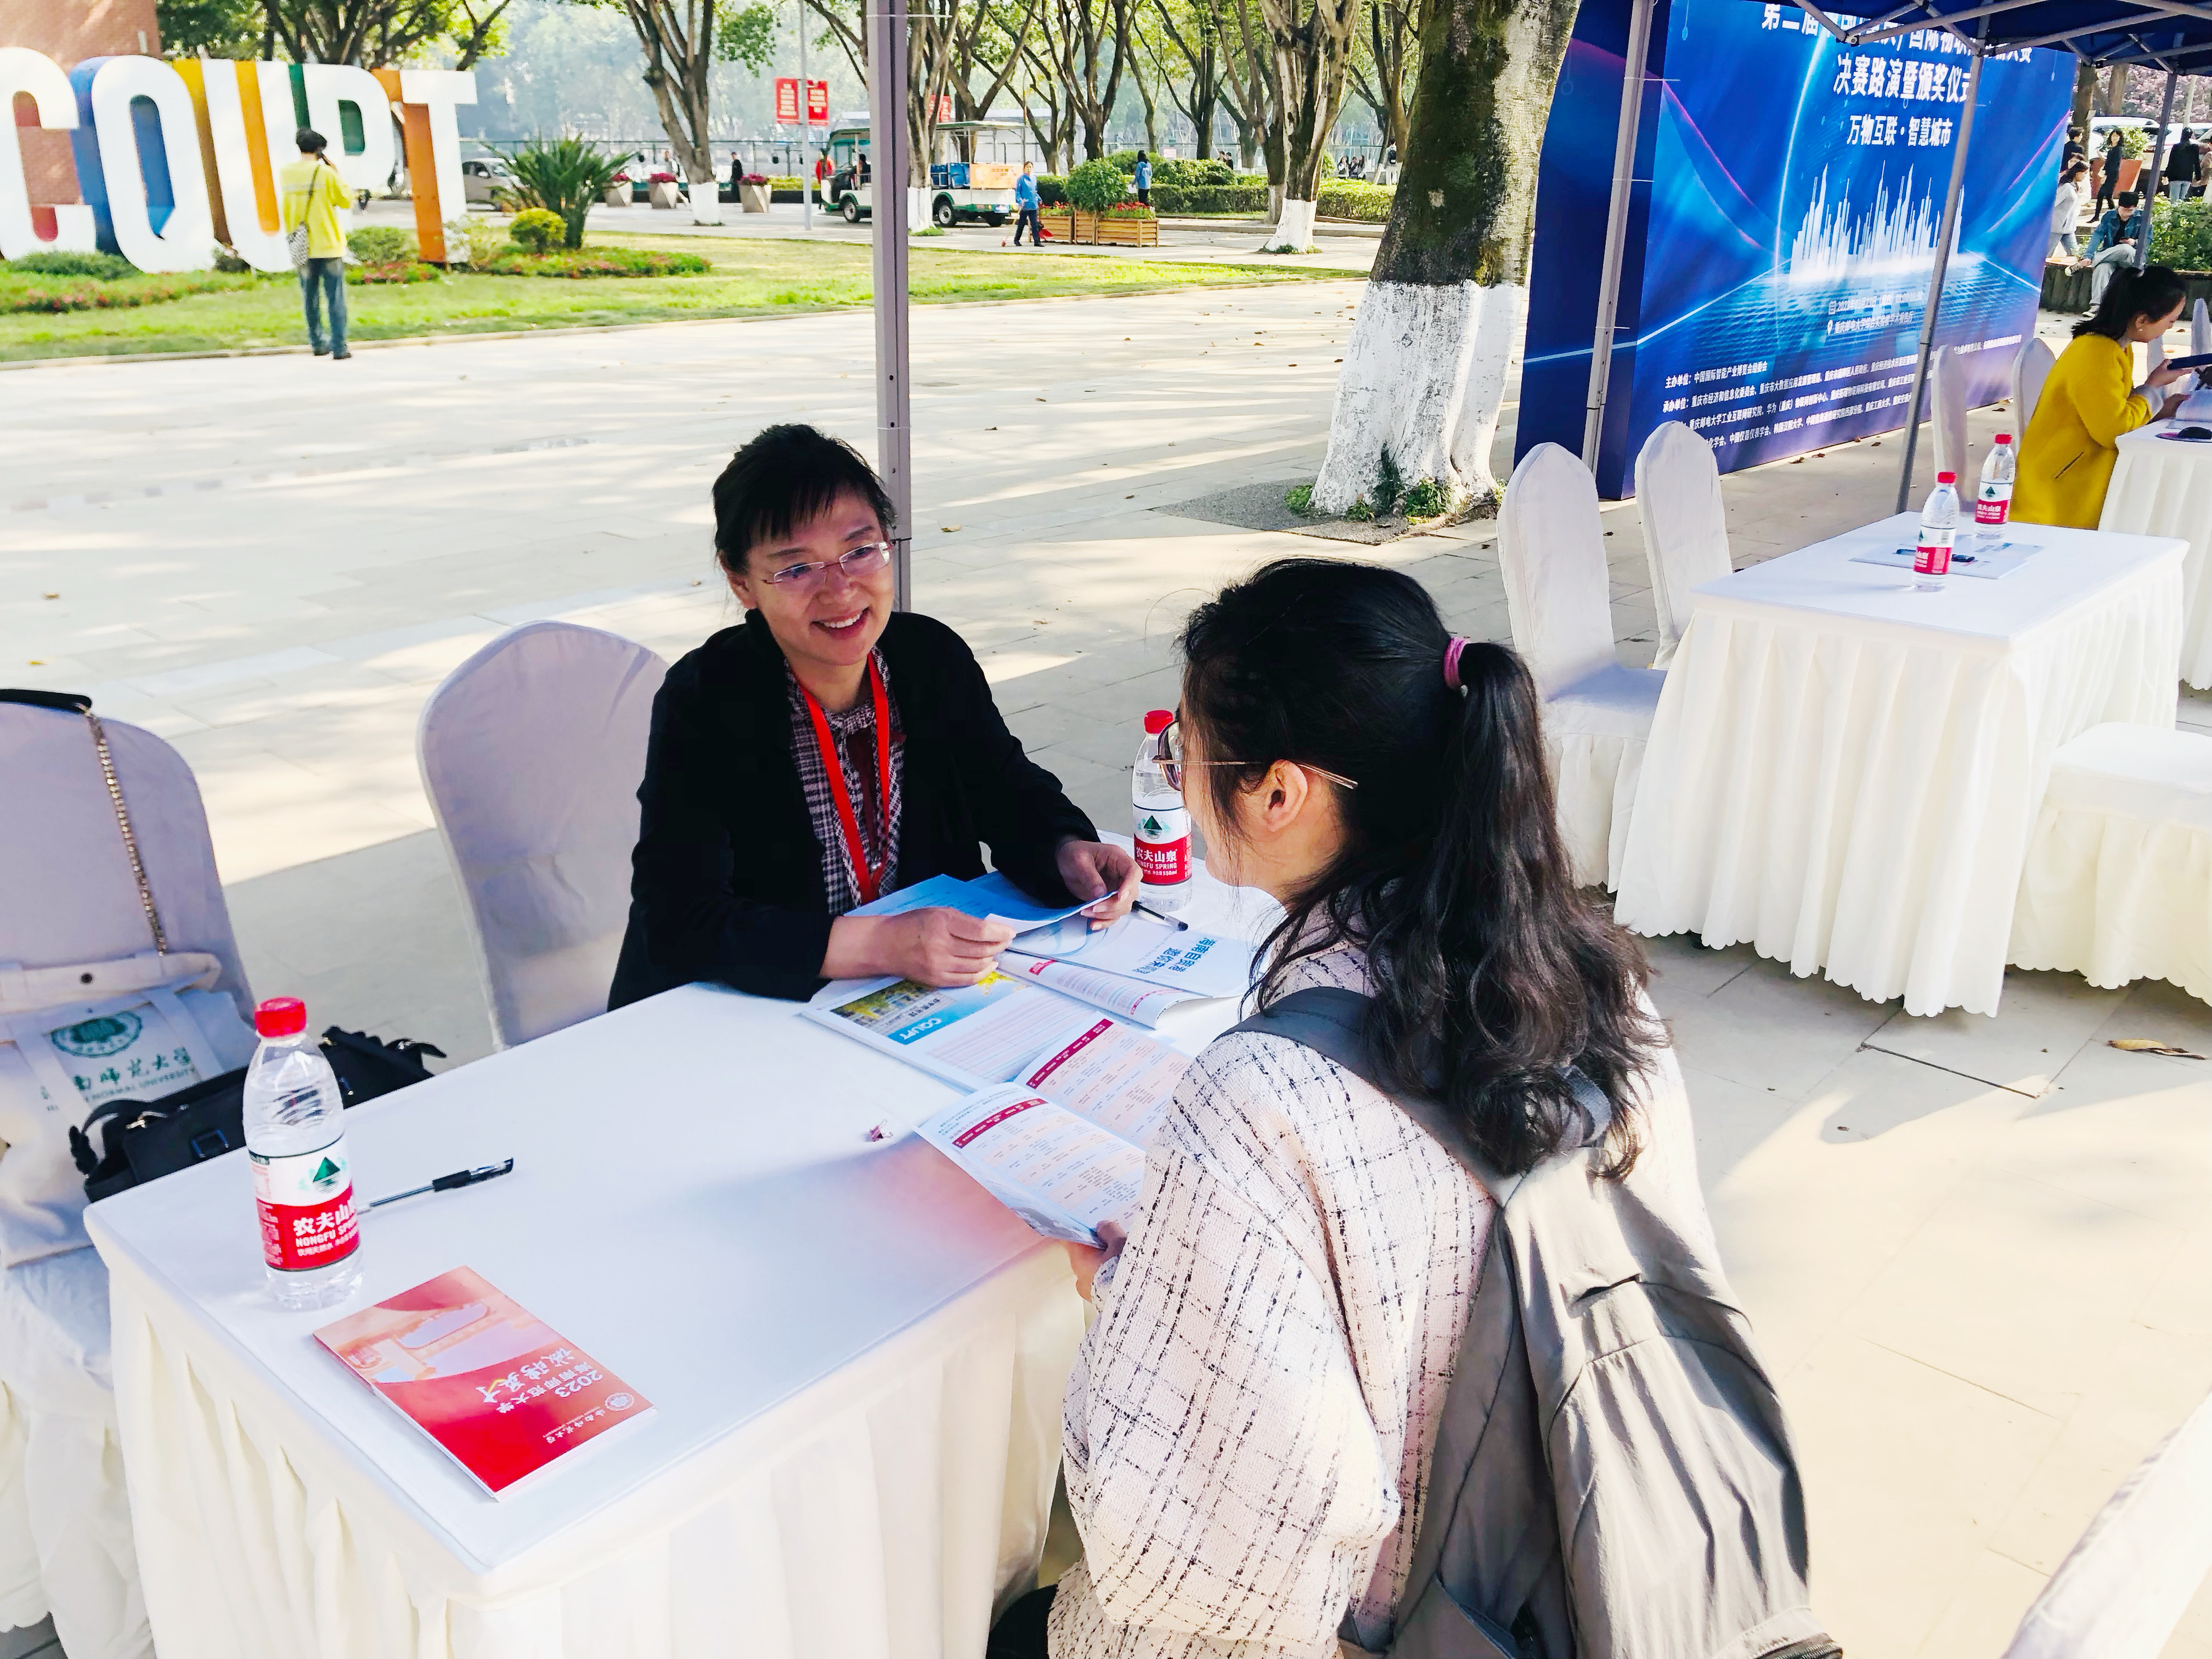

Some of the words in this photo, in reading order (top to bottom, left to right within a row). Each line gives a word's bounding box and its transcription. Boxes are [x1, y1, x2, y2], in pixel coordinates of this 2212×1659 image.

[1833, 53, 1971, 103] 决赛路演暨颁奖仪式
[1847, 114, 1953, 148] 万物互联·智慧城市
[1136, 847, 1177, 863] 农夫山泉
[1155, 862, 1177, 870] SPRING
[1168, 937, 1218, 972] 海南自贸港
[295, 1229, 336, 1248] NONGFU
[496, 1361, 592, 1414] 海南师范大学
[554, 1369, 603, 1398] 2023
